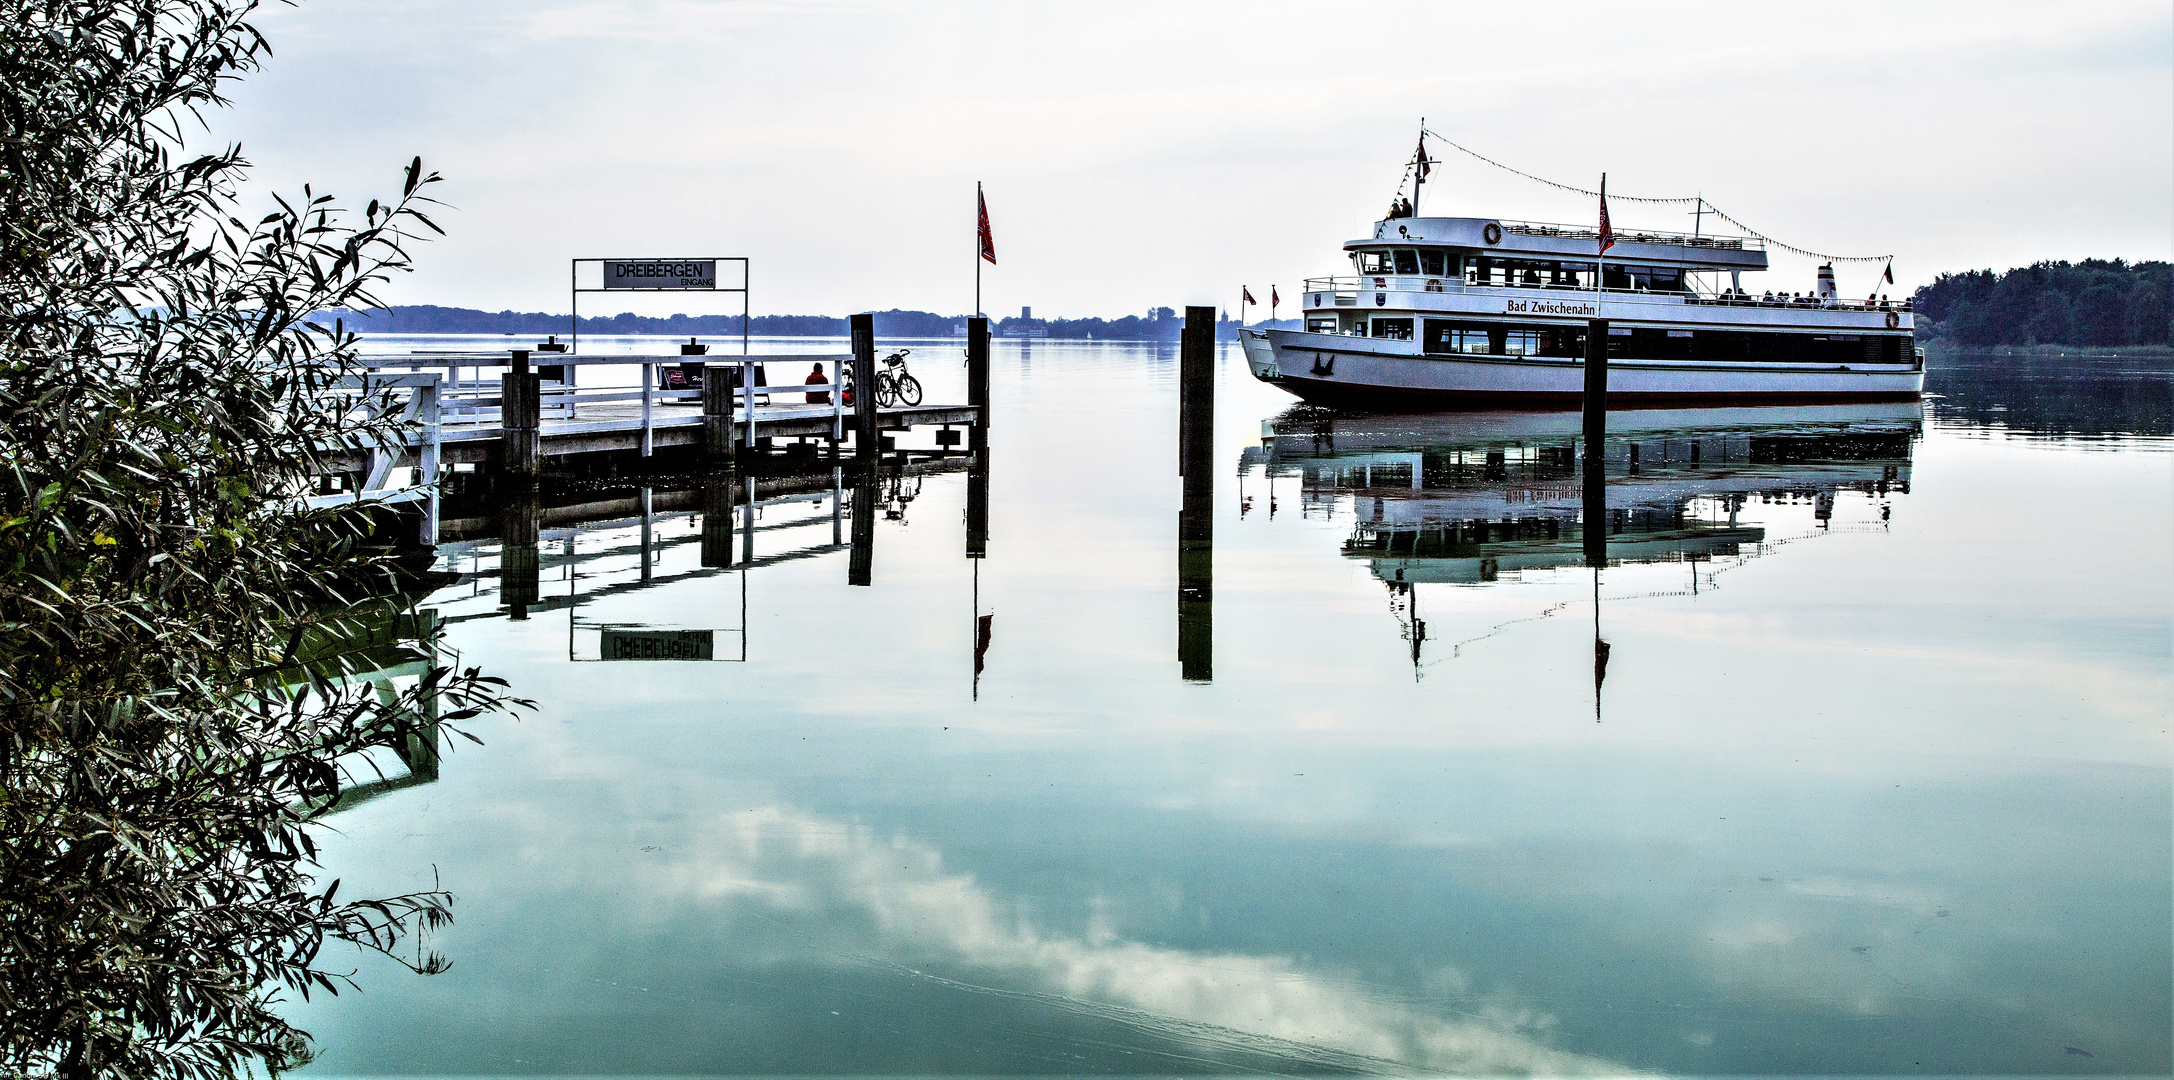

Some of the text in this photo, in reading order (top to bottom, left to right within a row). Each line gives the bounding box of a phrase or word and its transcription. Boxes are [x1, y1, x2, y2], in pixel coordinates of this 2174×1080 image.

[616, 263, 703, 278] DREIBERGEN
[680, 278, 714, 286] EINGANG
[1507, 300, 1595, 315] Bad Zwischenahn
